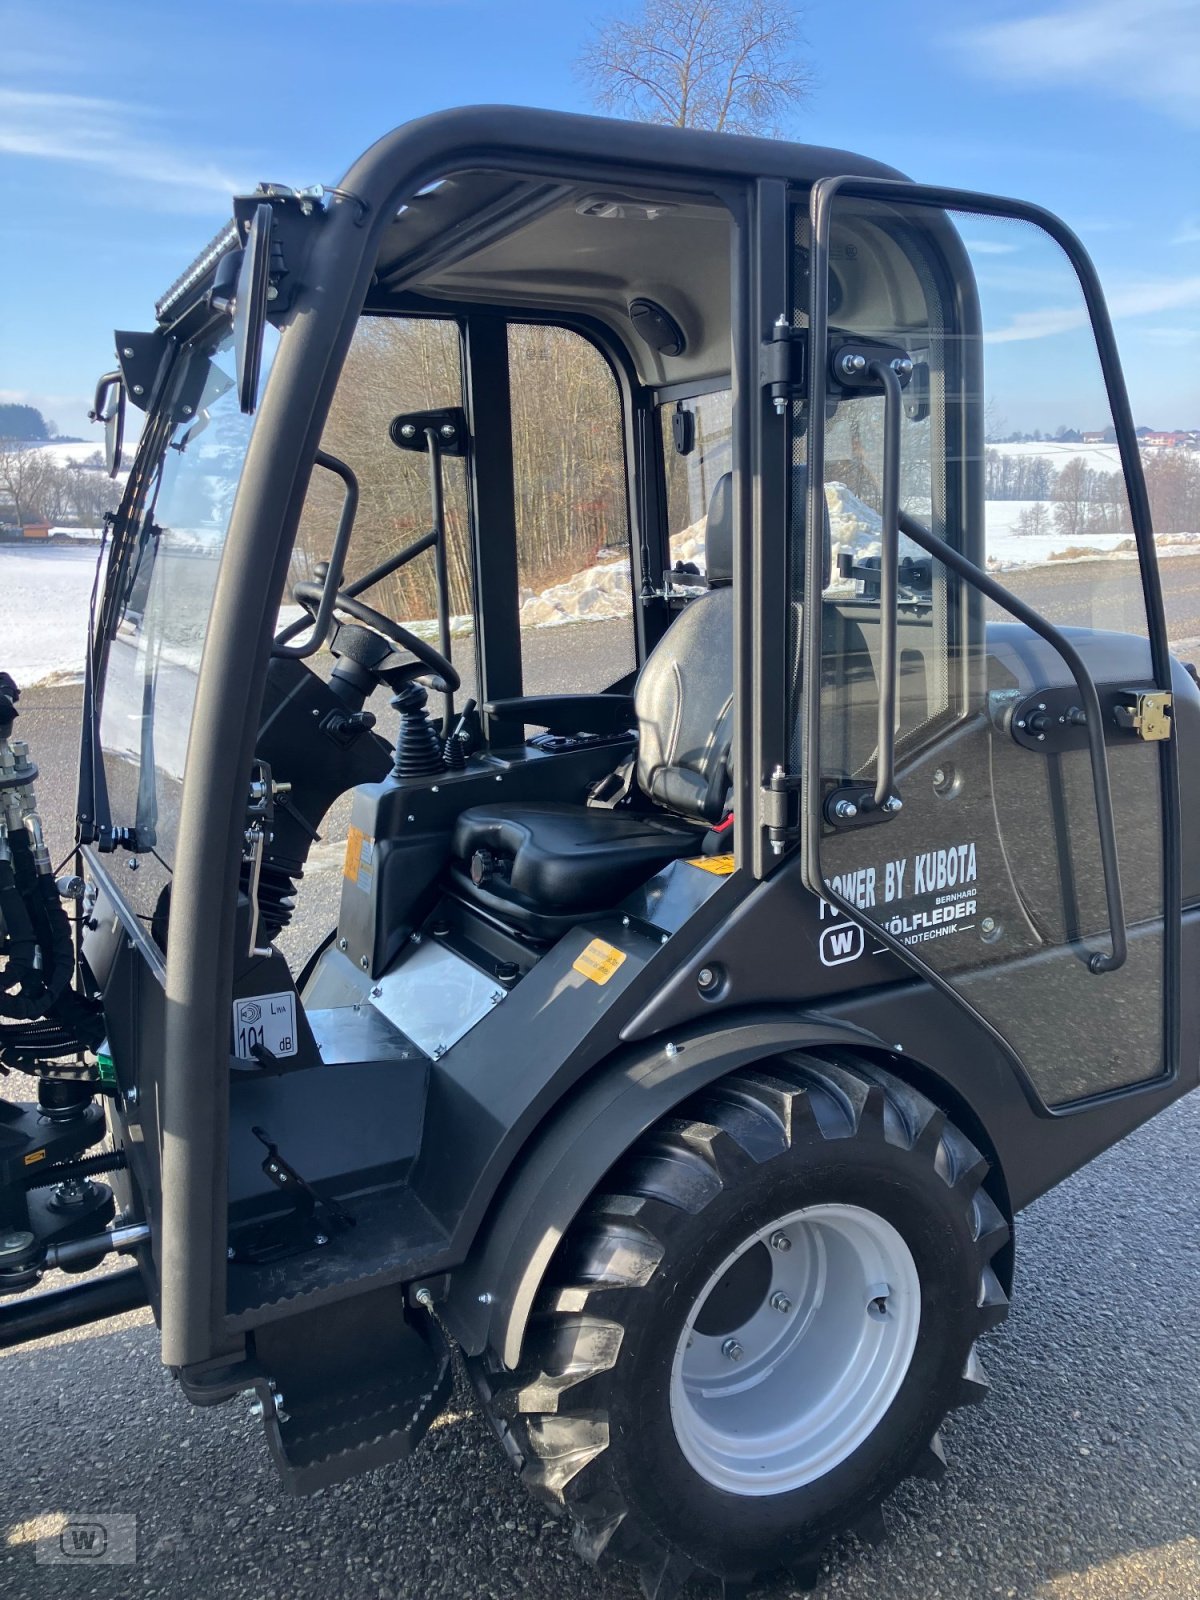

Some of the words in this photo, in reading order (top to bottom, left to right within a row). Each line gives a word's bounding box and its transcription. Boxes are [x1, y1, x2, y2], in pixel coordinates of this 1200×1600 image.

[885, 858, 906, 903] BY
[914, 842, 978, 895] KUBOTA
[935, 888, 977, 906] BERNHARD
[873, 900, 977, 939] ÖLFLEDER
[830, 930, 853, 956] W
[898, 923, 958, 946] NDTECHNIK
[239, 1024, 265, 1058] 101
[279, 1036, 292, 1051] dB
